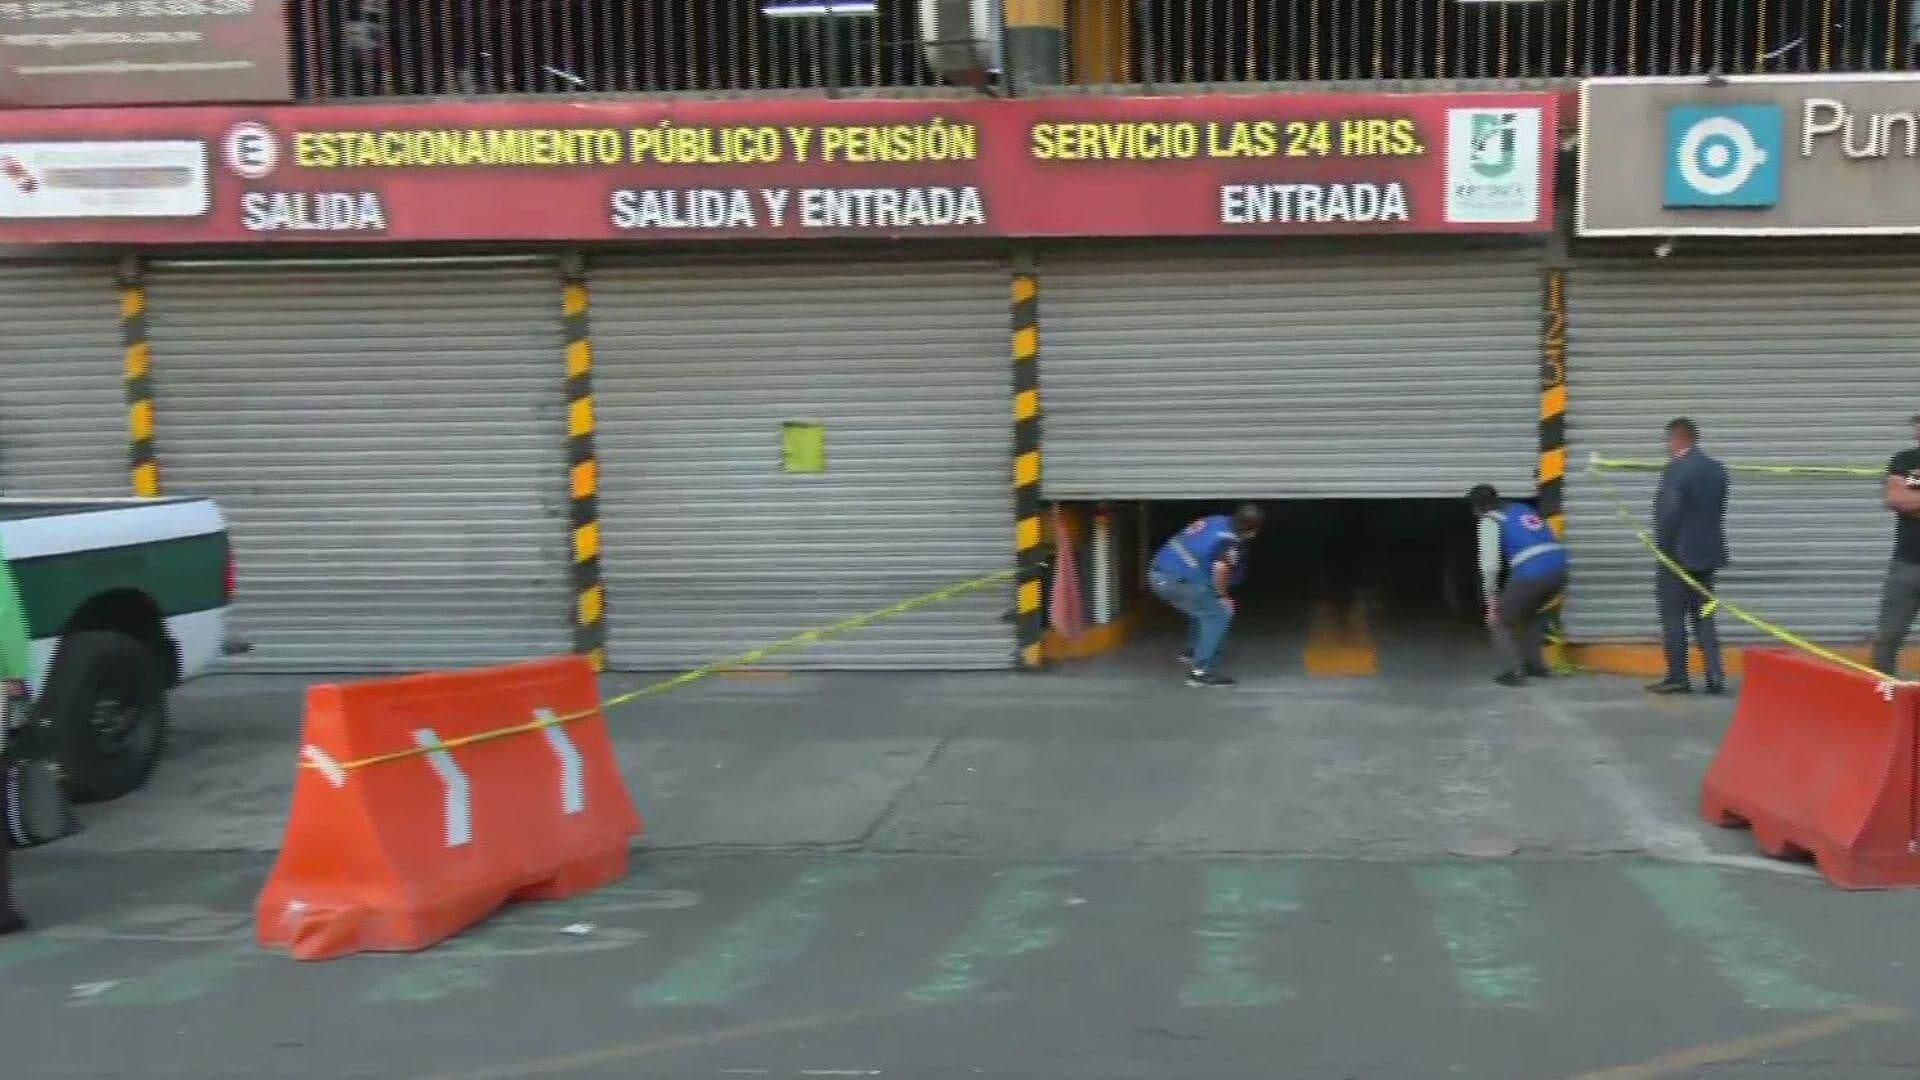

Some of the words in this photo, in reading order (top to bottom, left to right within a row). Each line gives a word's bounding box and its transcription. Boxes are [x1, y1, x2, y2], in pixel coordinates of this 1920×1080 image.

[295, 129, 623, 167] ESTACIONAMIENTO
[629, 119, 783, 164] PÚBLICO
[787, 126, 813, 162] Y
[821, 116, 977, 161] PENSIÓN
[1031, 122, 1200, 160] SERVICIO
[1207, 121, 1280, 158] LAS
[1286, 121, 1332, 157] 24
[1339, 119, 1425, 156] HRS.
[1801, 98, 1920, 159] Pun
[237, 134, 264, 166] E
[241, 192, 386, 231] SALIDA
[611, 189, 756, 228] SALIDA
[761, 189, 791, 228] Y
[800, 187, 986, 227] ENTRADA
[1219, 183, 1410, 224] ENTRADA
